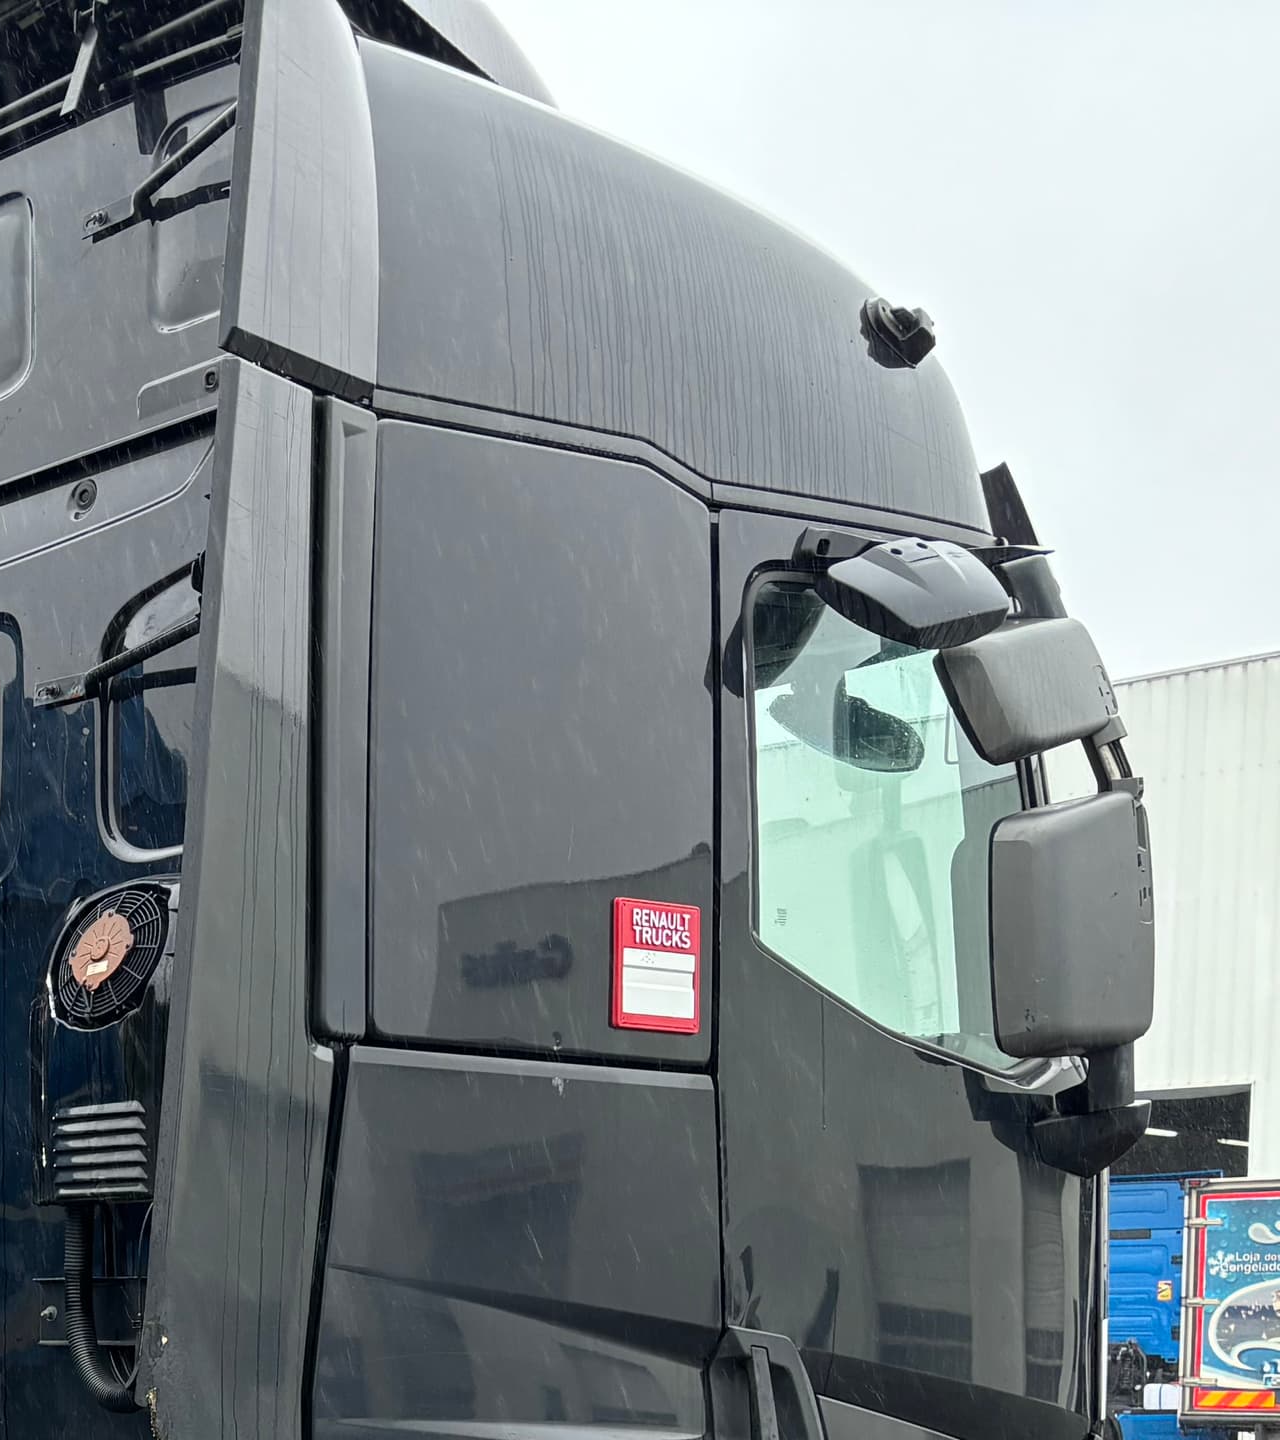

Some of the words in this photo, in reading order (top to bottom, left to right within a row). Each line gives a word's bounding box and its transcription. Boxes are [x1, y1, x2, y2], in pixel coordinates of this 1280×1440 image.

[632, 908, 691, 931] RENAULT
[633, 926, 691, 949] TRUCKS
[1235, 1251, 1260, 1263] Loja
